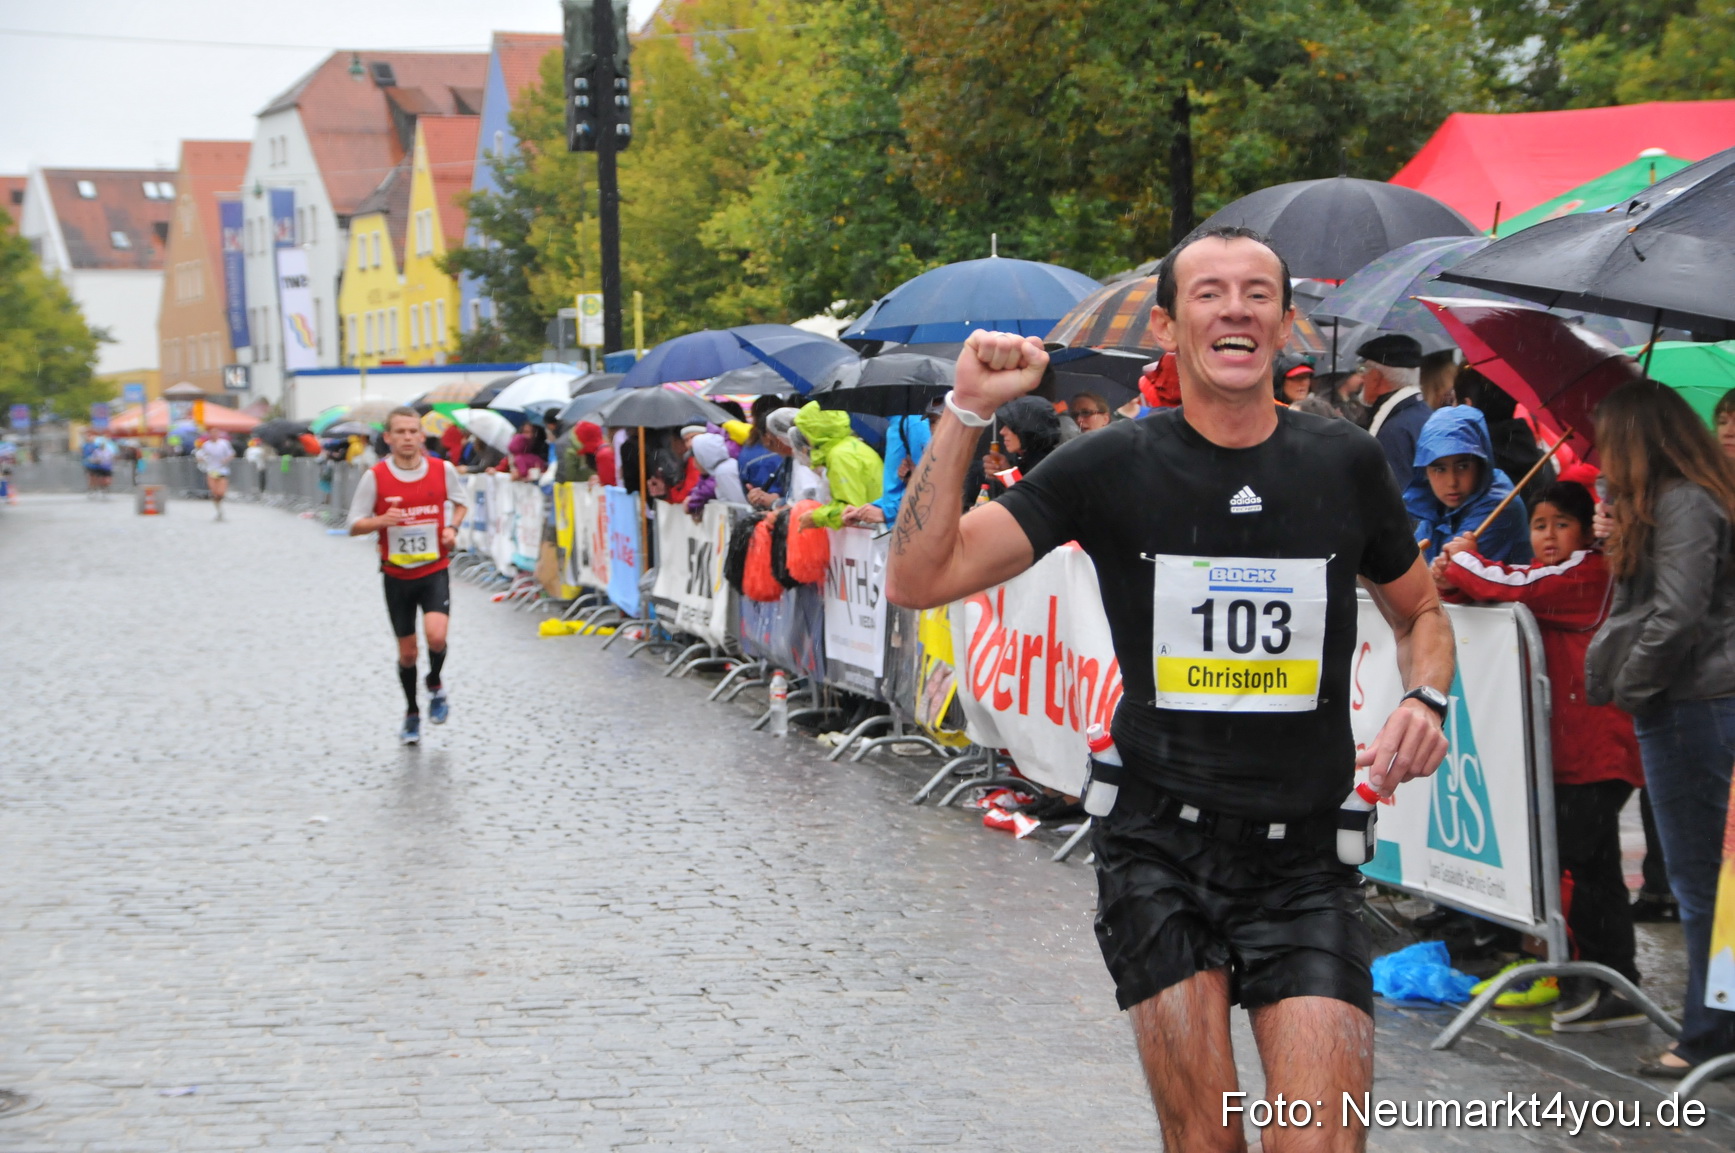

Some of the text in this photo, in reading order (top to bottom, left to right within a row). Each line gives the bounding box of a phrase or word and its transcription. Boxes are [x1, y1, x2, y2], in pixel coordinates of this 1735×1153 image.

[1229, 496, 1262, 506] adidas
[398, 536, 427, 553] 213
[1209, 567, 1277, 583] BOCK
[1191, 598, 1292, 655] 103
[1187, 665, 1288, 693] Christoph
